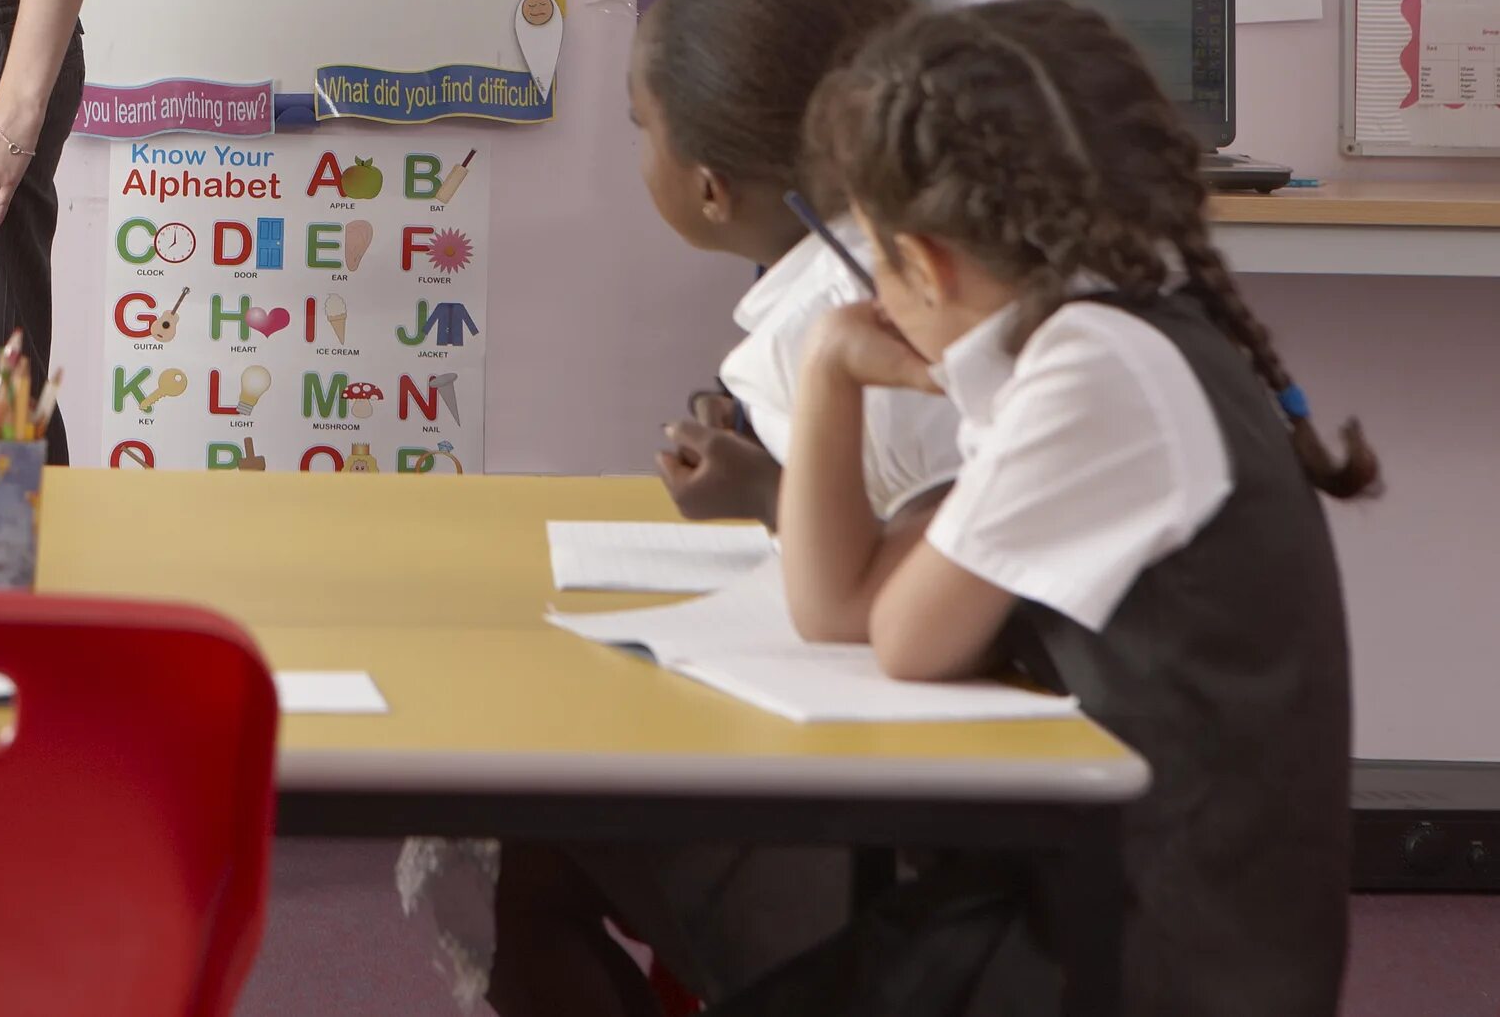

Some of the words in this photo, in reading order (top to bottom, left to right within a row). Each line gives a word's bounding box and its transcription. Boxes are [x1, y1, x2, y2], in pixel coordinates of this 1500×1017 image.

[323, 75, 369, 103] What
[374, 79, 399, 106] did
[405, 85, 436, 114] you
[441, 75, 473, 103] find
[83, 100, 109, 127] you
[115, 96, 157, 124] learnt
[161, 91, 223, 127] anything
[228, 92, 267, 122] new?
[131, 143, 206, 167] Know
[214, 145, 274, 167] Your
[122, 169, 282, 204] Alphabet
[429, 205, 445, 213] BAT
[137, 269, 164, 277] CLOCK
[234, 271, 258, 279] DOOR
[331, 274, 348, 282] EAR
[418, 276, 451, 284] FLOWER
[133, 343, 164, 351] GUITAR
[316, 348, 331, 356] ICE
[332, 348, 360, 357] CREAM
[417, 350, 448, 359] JACKET
[138, 418, 155, 426] KEY
[230, 420, 254, 428] LIGHT
[312, 423, 360, 431] MUSHROOM
[422, 425, 441, 433] NAIL
